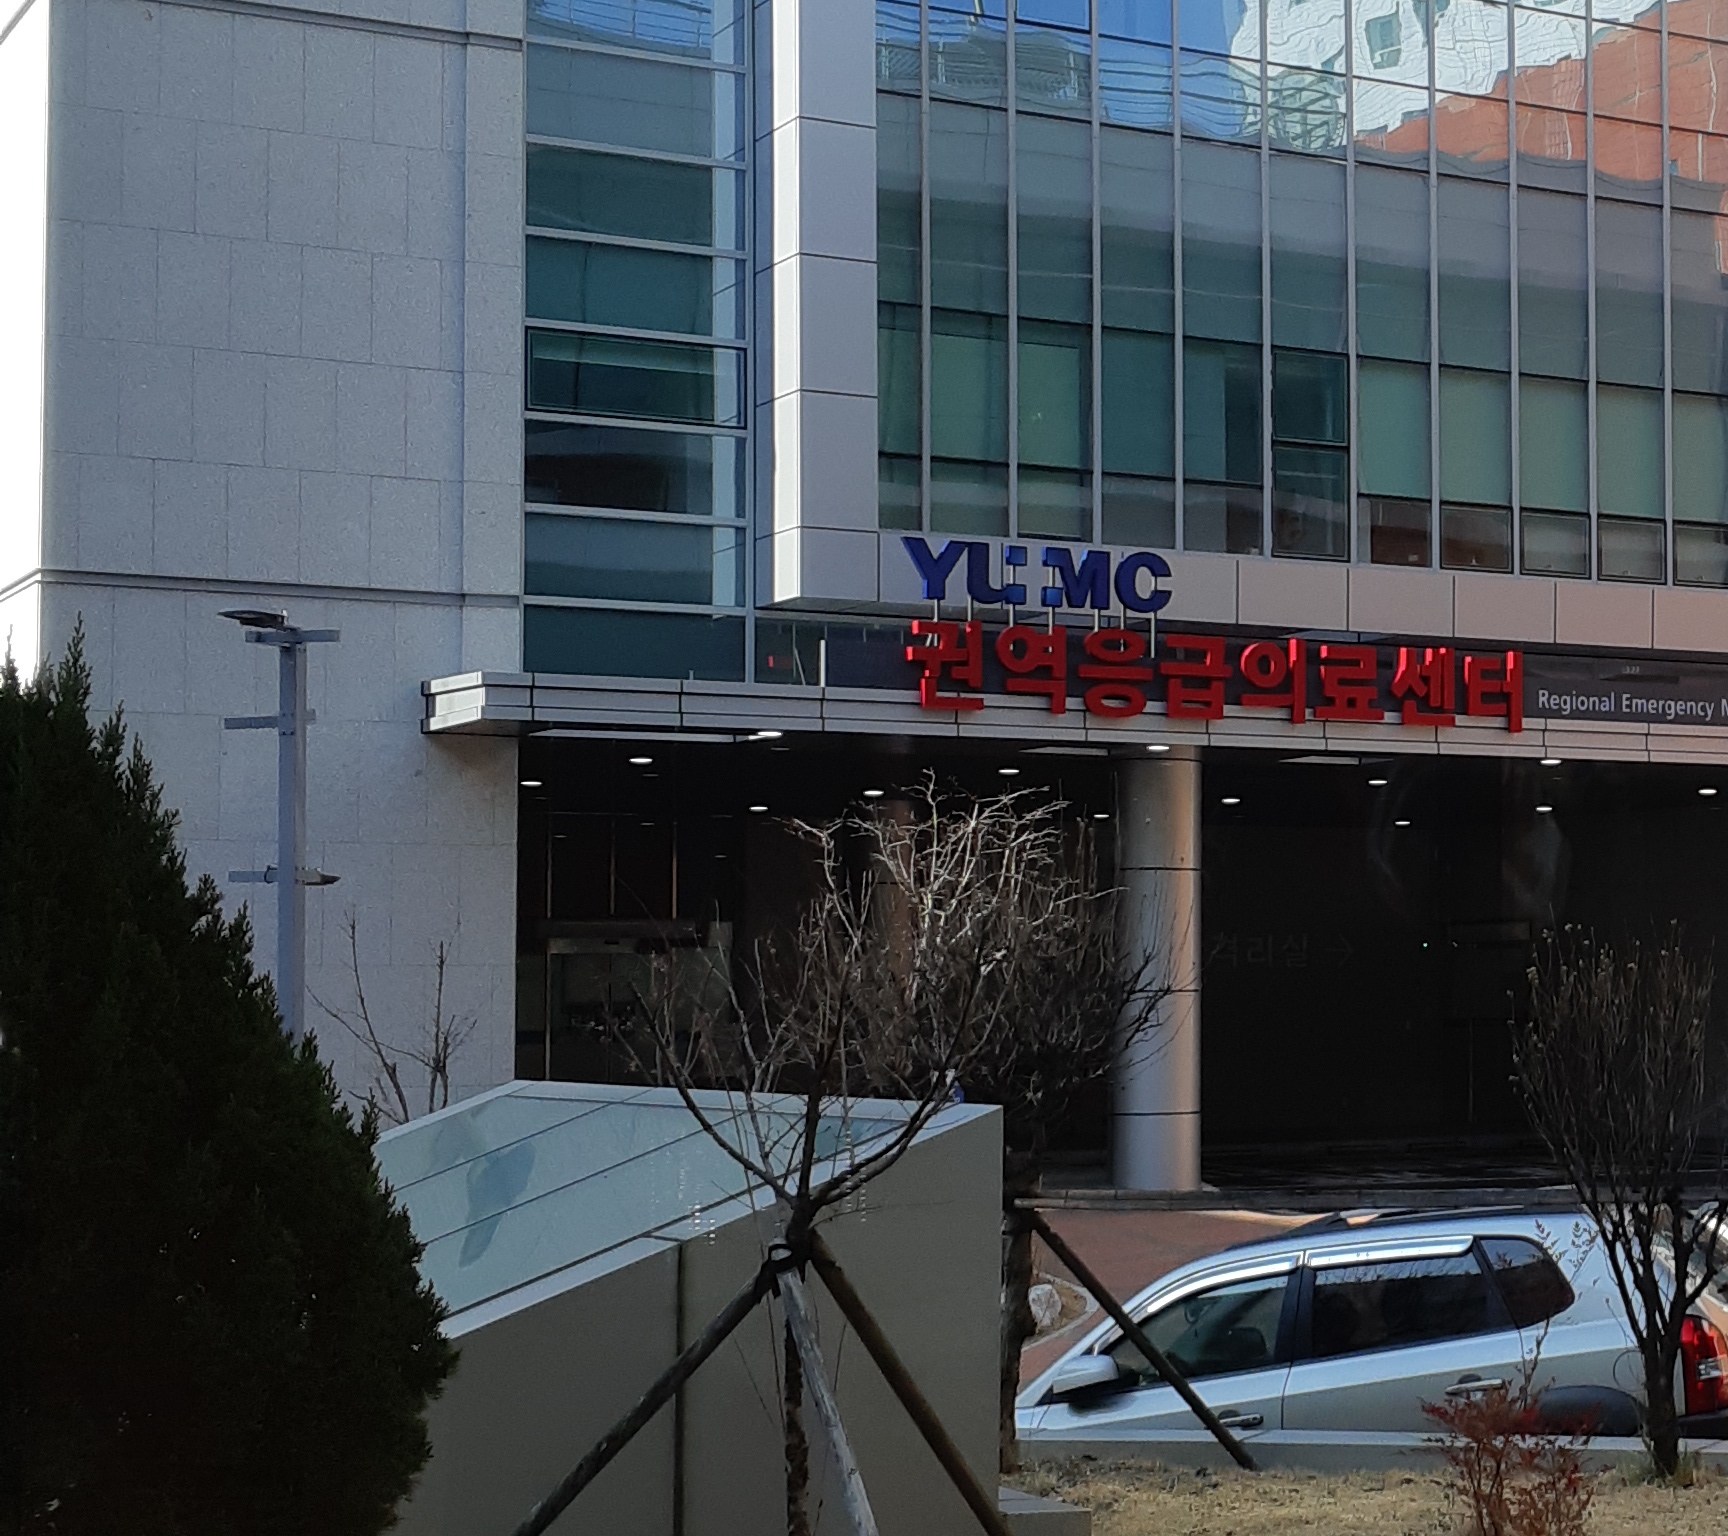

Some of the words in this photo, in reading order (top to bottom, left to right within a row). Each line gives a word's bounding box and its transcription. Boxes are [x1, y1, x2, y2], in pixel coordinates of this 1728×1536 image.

[906, 619, 1524, 733] 권역응급의료센터
[1538, 689, 1615, 714] Regional
[1622, 693, 1715, 721] Emergency
